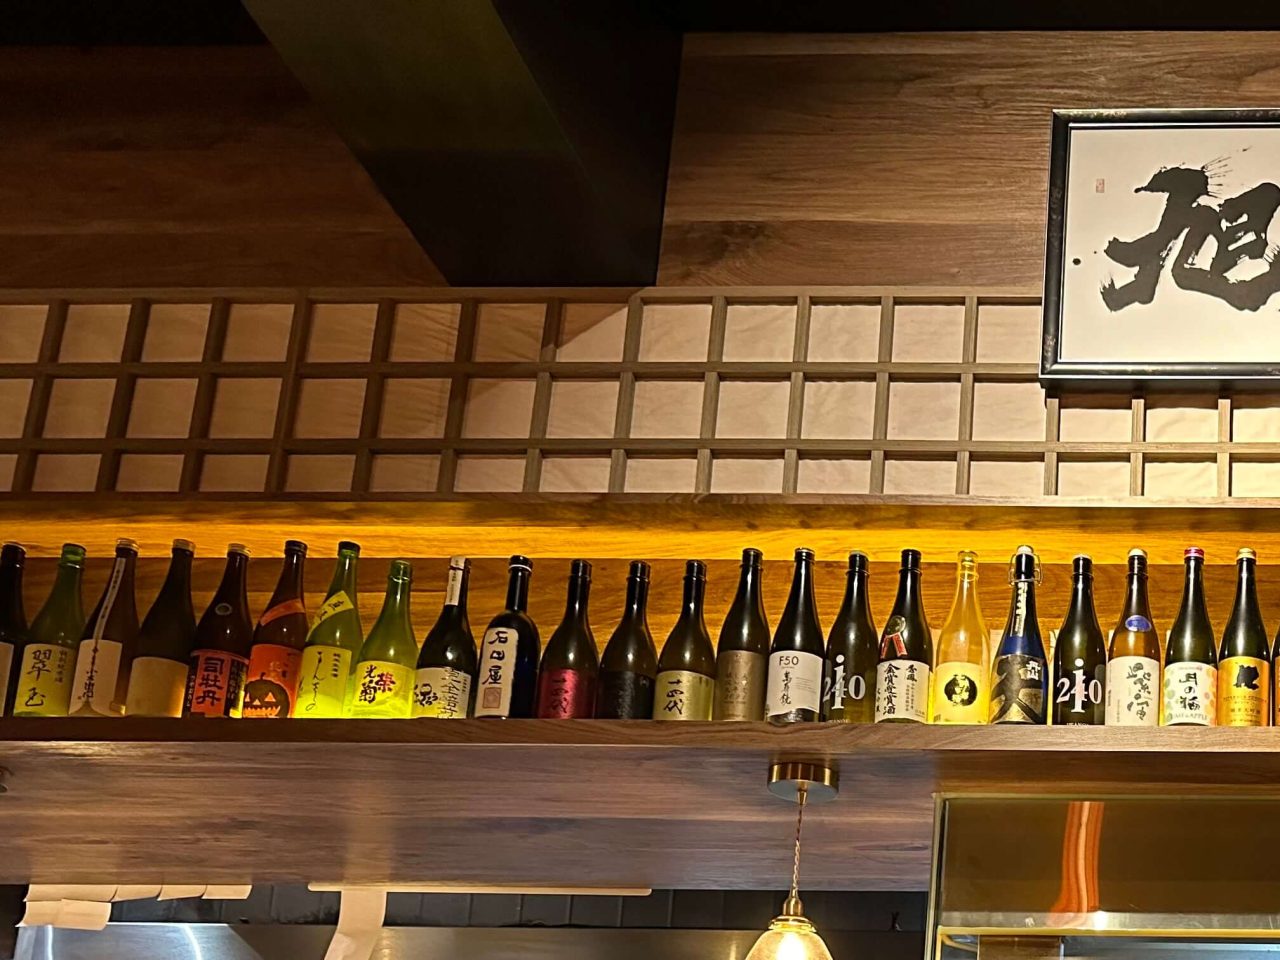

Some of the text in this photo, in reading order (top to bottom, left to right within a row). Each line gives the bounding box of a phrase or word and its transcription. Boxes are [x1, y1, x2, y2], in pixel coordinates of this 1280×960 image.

[482, 630, 509, 685] 石田屋
[778, 655, 800, 666] F50
[196, 657, 225, 707] 司牡丹
[663, 679, 685, 715] 十四代
